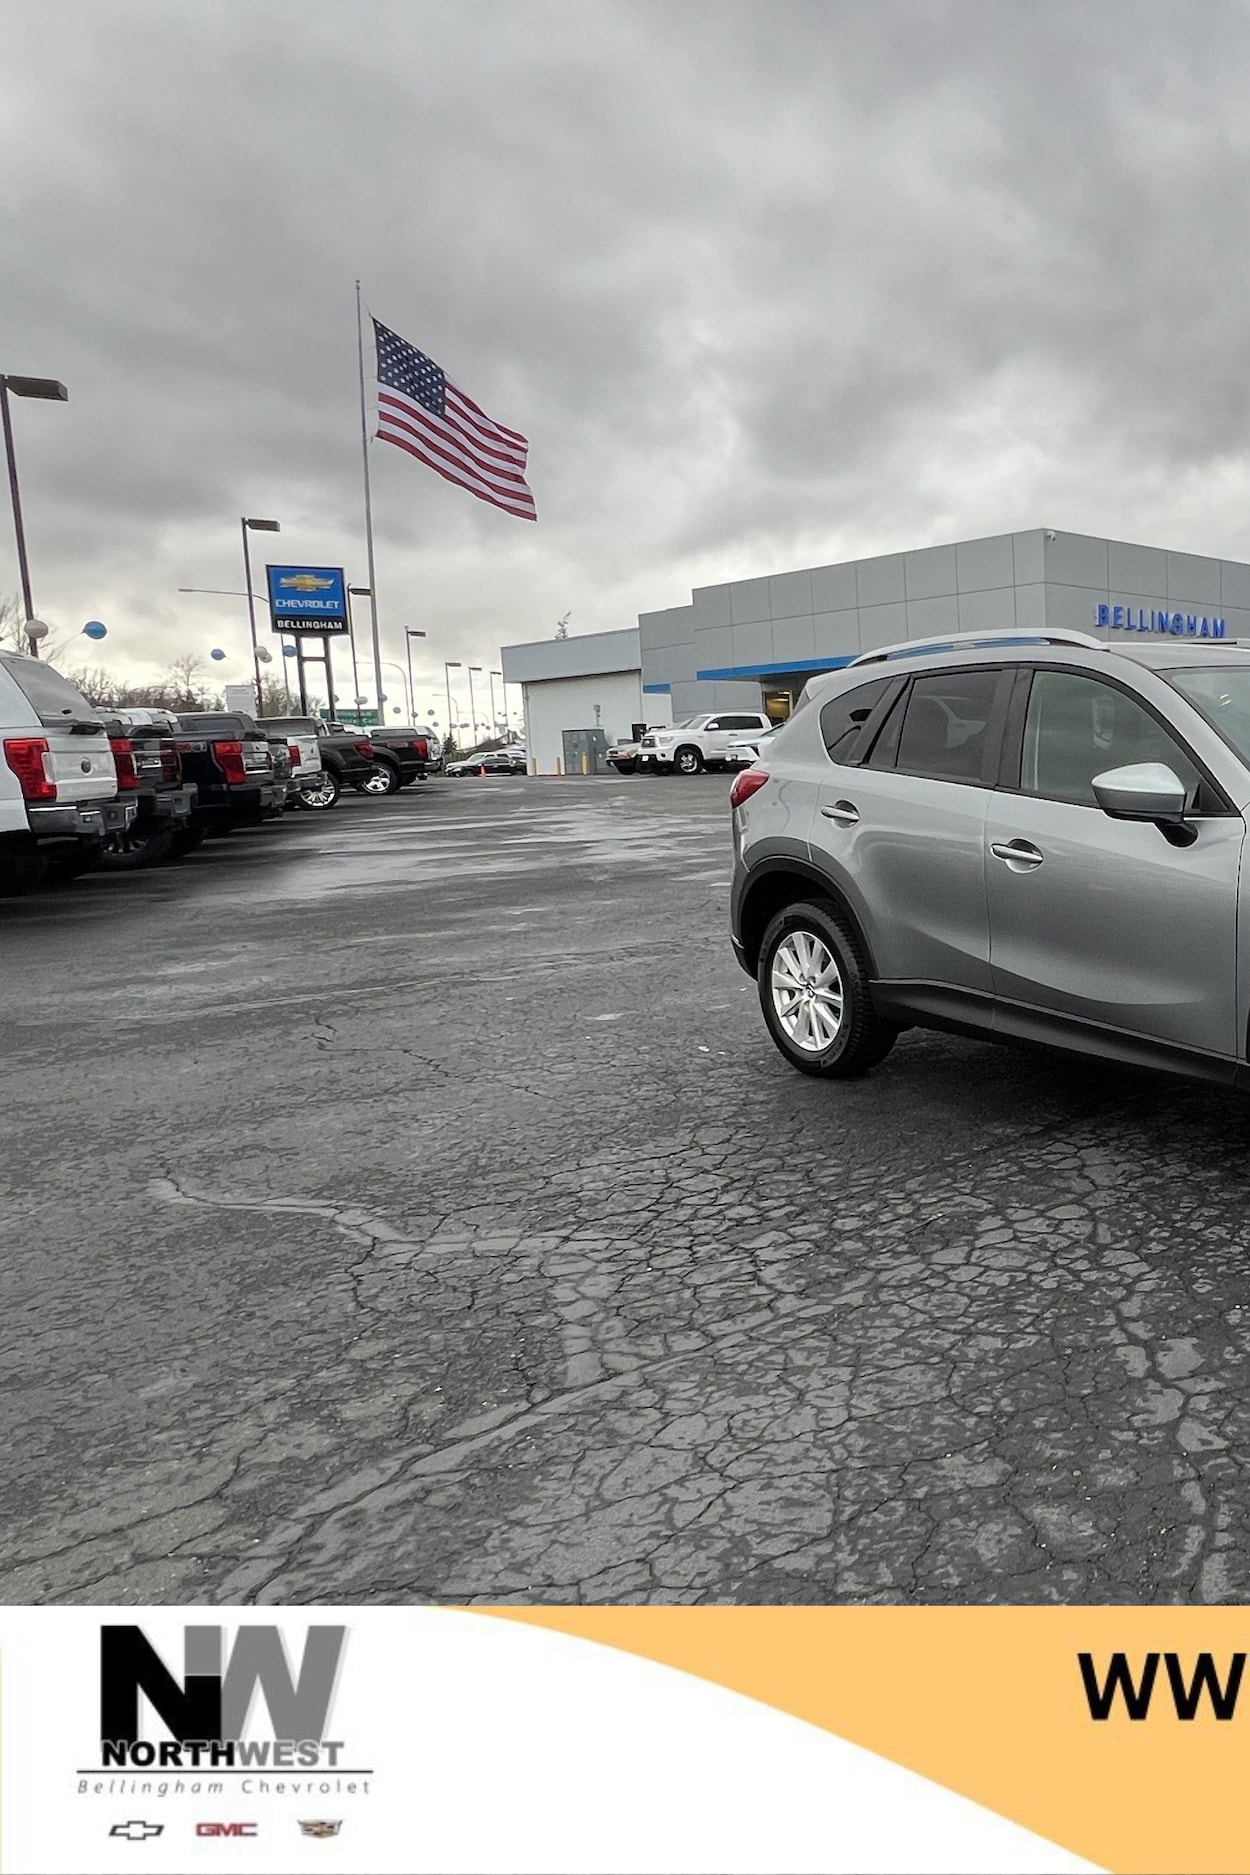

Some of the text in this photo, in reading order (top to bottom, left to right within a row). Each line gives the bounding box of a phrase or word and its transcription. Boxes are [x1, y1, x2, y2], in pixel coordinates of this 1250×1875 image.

[275, 599, 340, 610] CHEVROLET
[277, 620, 343, 630] BELLINGHAM
[1097, 603, 1226, 638] BELLINGHAM
